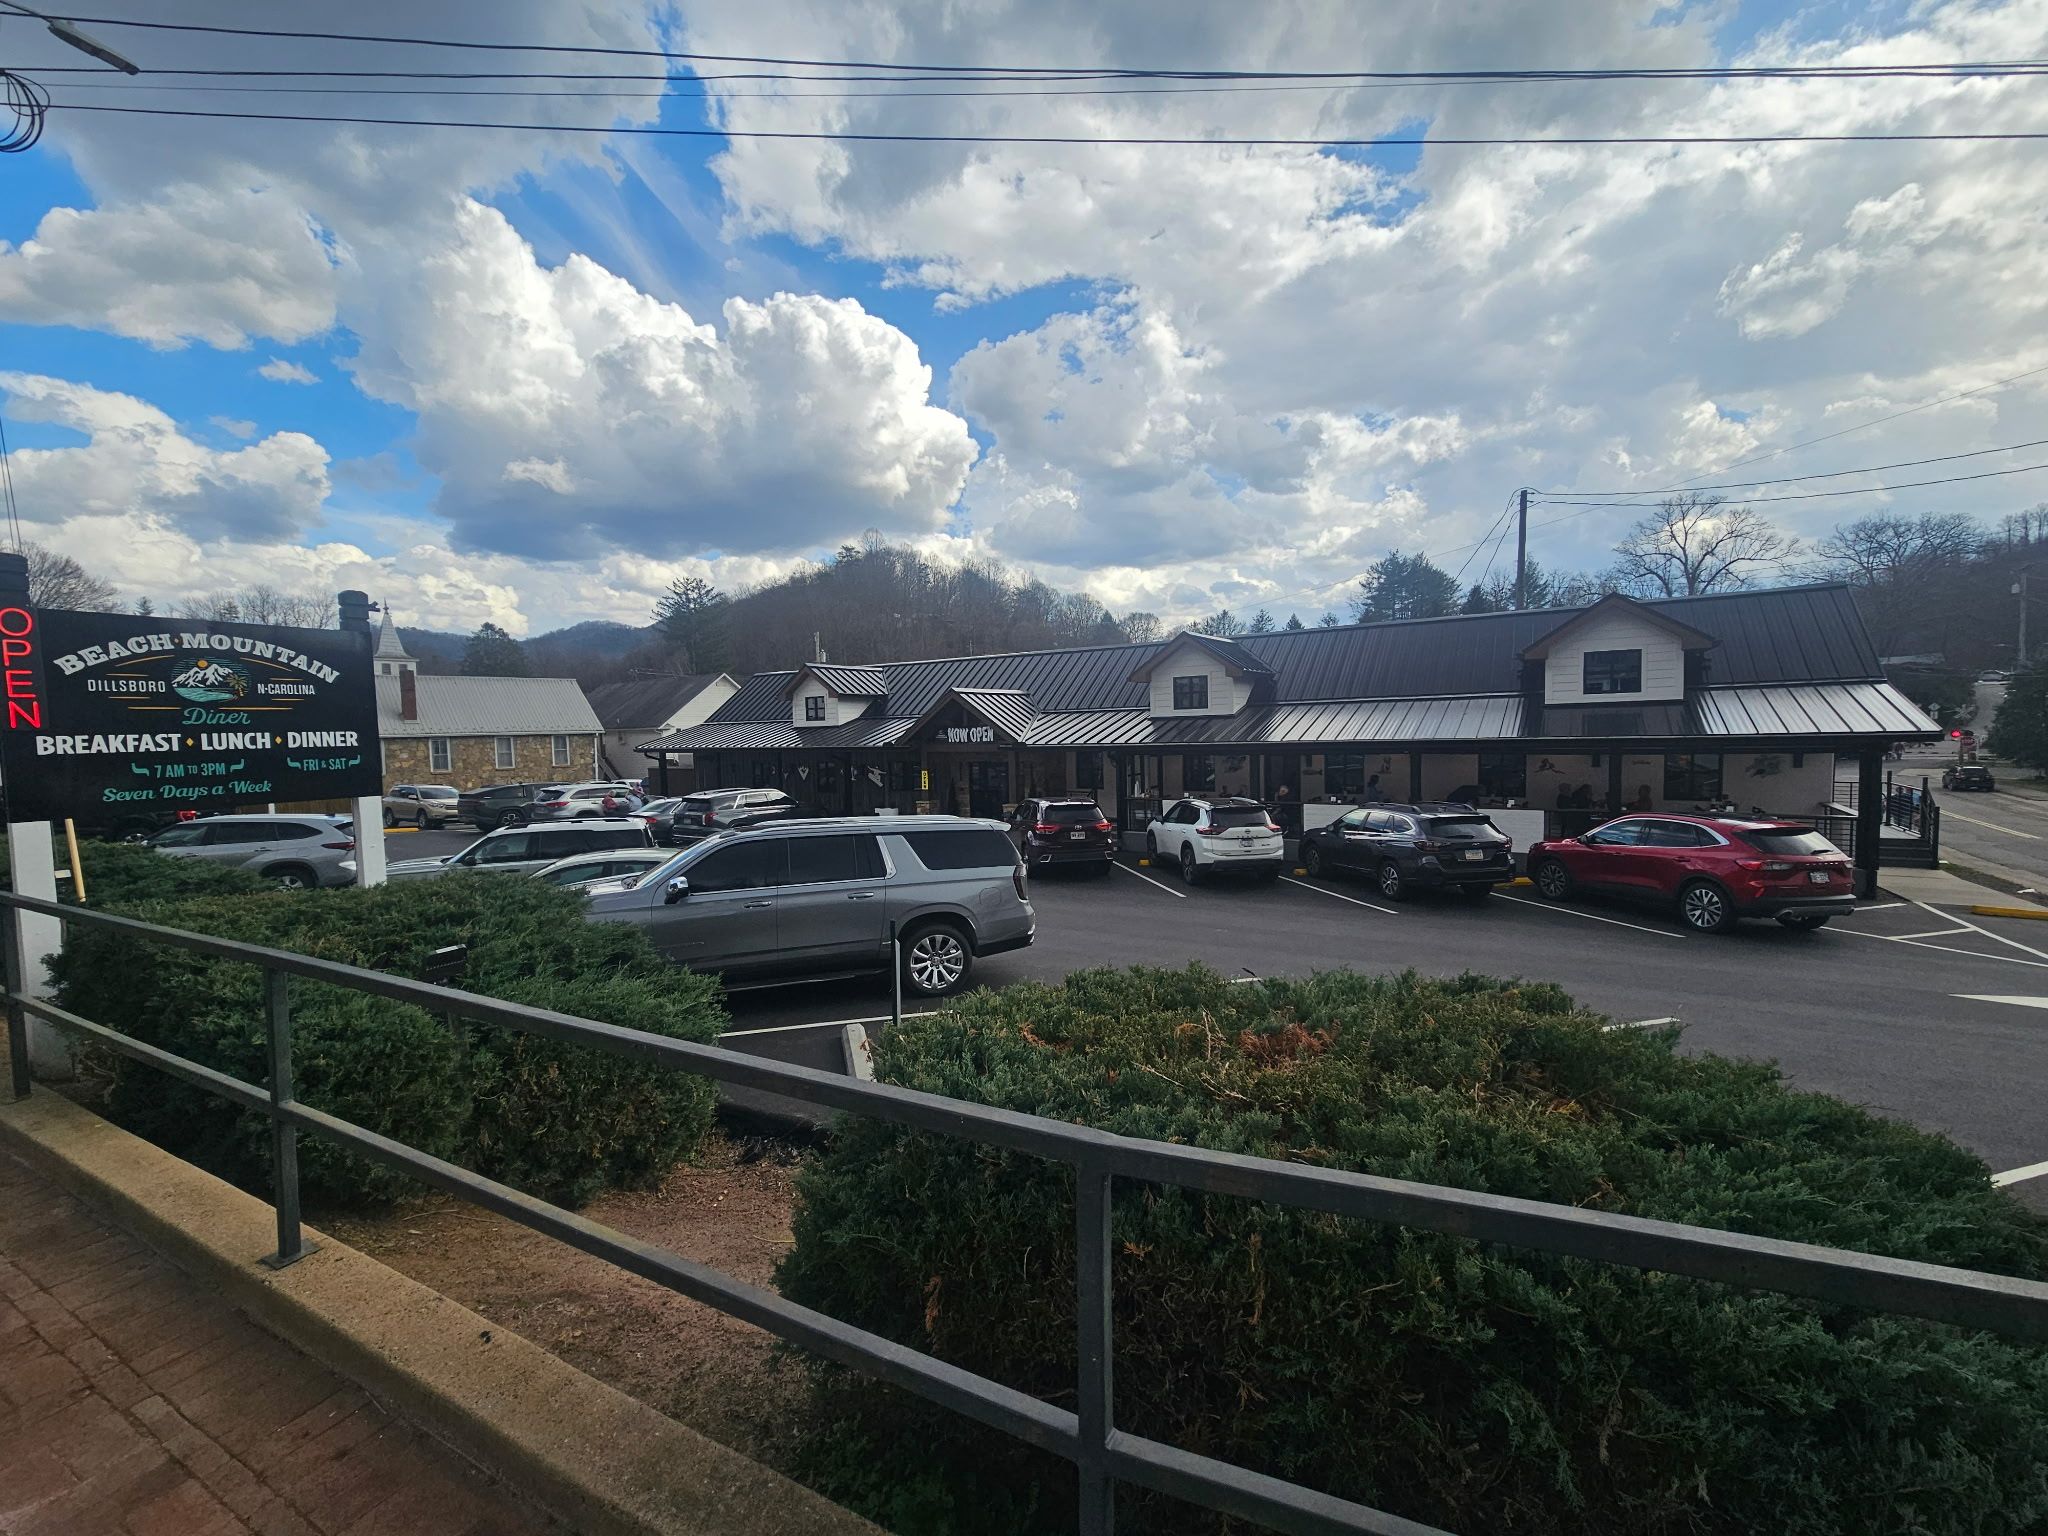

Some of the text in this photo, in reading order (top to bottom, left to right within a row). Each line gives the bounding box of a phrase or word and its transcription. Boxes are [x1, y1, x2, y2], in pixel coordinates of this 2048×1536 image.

[0, 607, 41, 729] OPEN
[53, 633, 341, 684] BEACH MOUNTAIN
[88, 679, 166, 693] DILLSBORO
[182, 707, 251, 726] Diner
[35, 731, 358, 756] BREAKFAST LUNCH DINNER
[947, 726, 993, 742] NOW OPEN
[154, 762, 226, 779] 7 AM TO 3PM
[303, 759, 319, 771] FRI
[328, 758, 347, 770] SAT
[103, 780, 272, 802] Seven Days a Week
